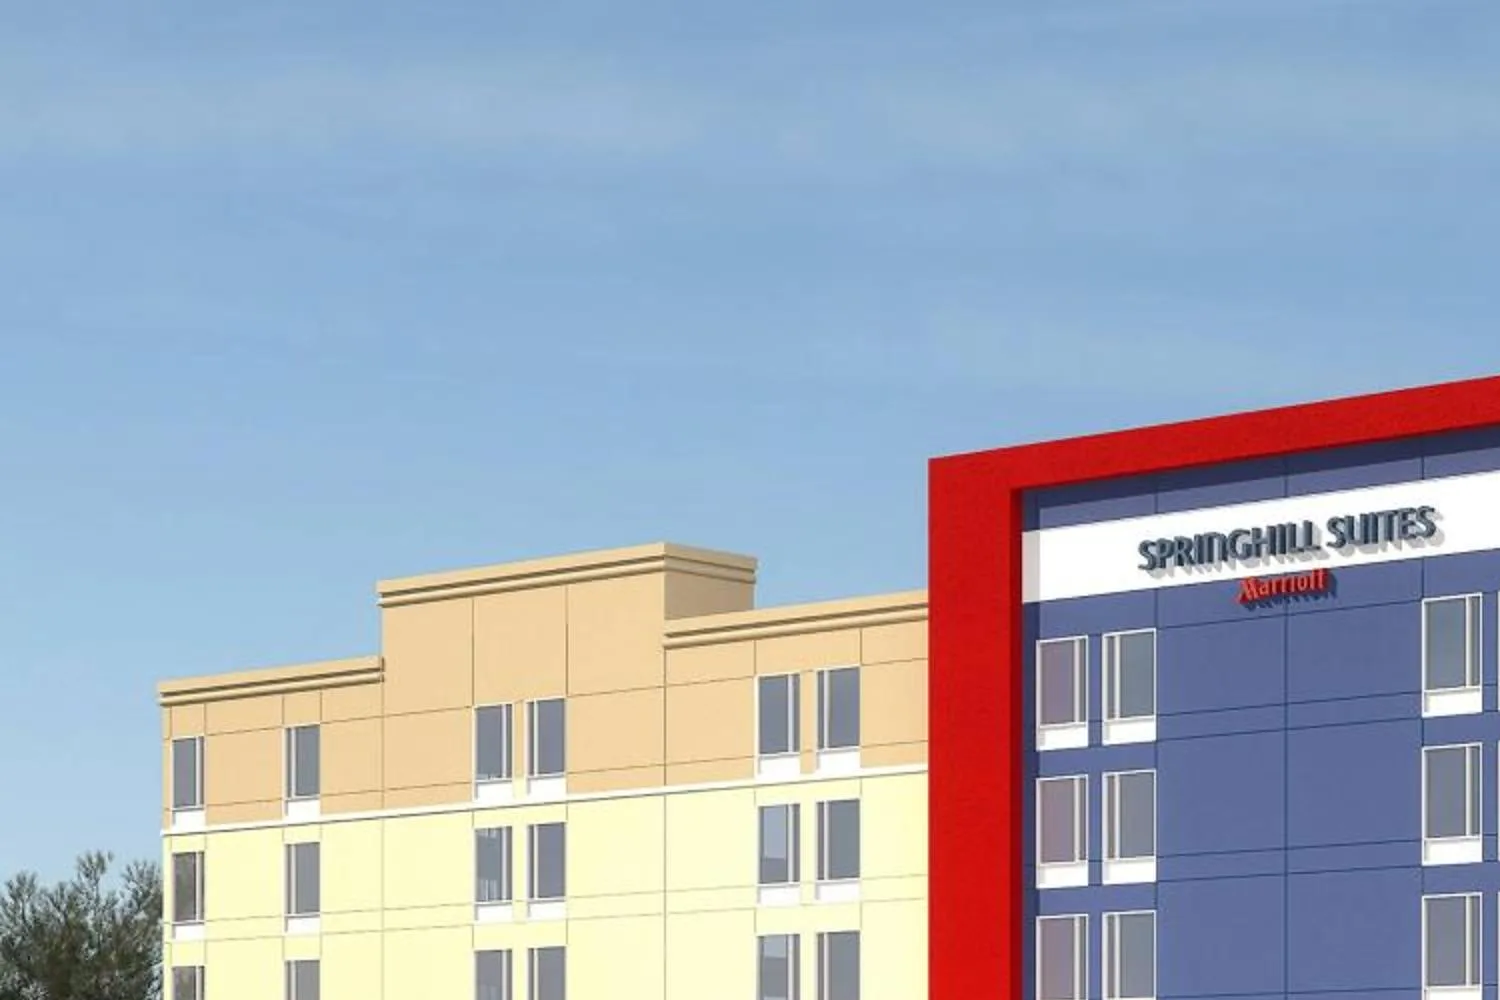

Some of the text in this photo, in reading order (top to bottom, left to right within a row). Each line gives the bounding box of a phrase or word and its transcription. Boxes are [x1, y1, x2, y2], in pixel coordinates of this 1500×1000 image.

[1138, 505, 1437, 571] SPRINGHILL SUITES
[1236, 568, 1329, 605] Marriott
